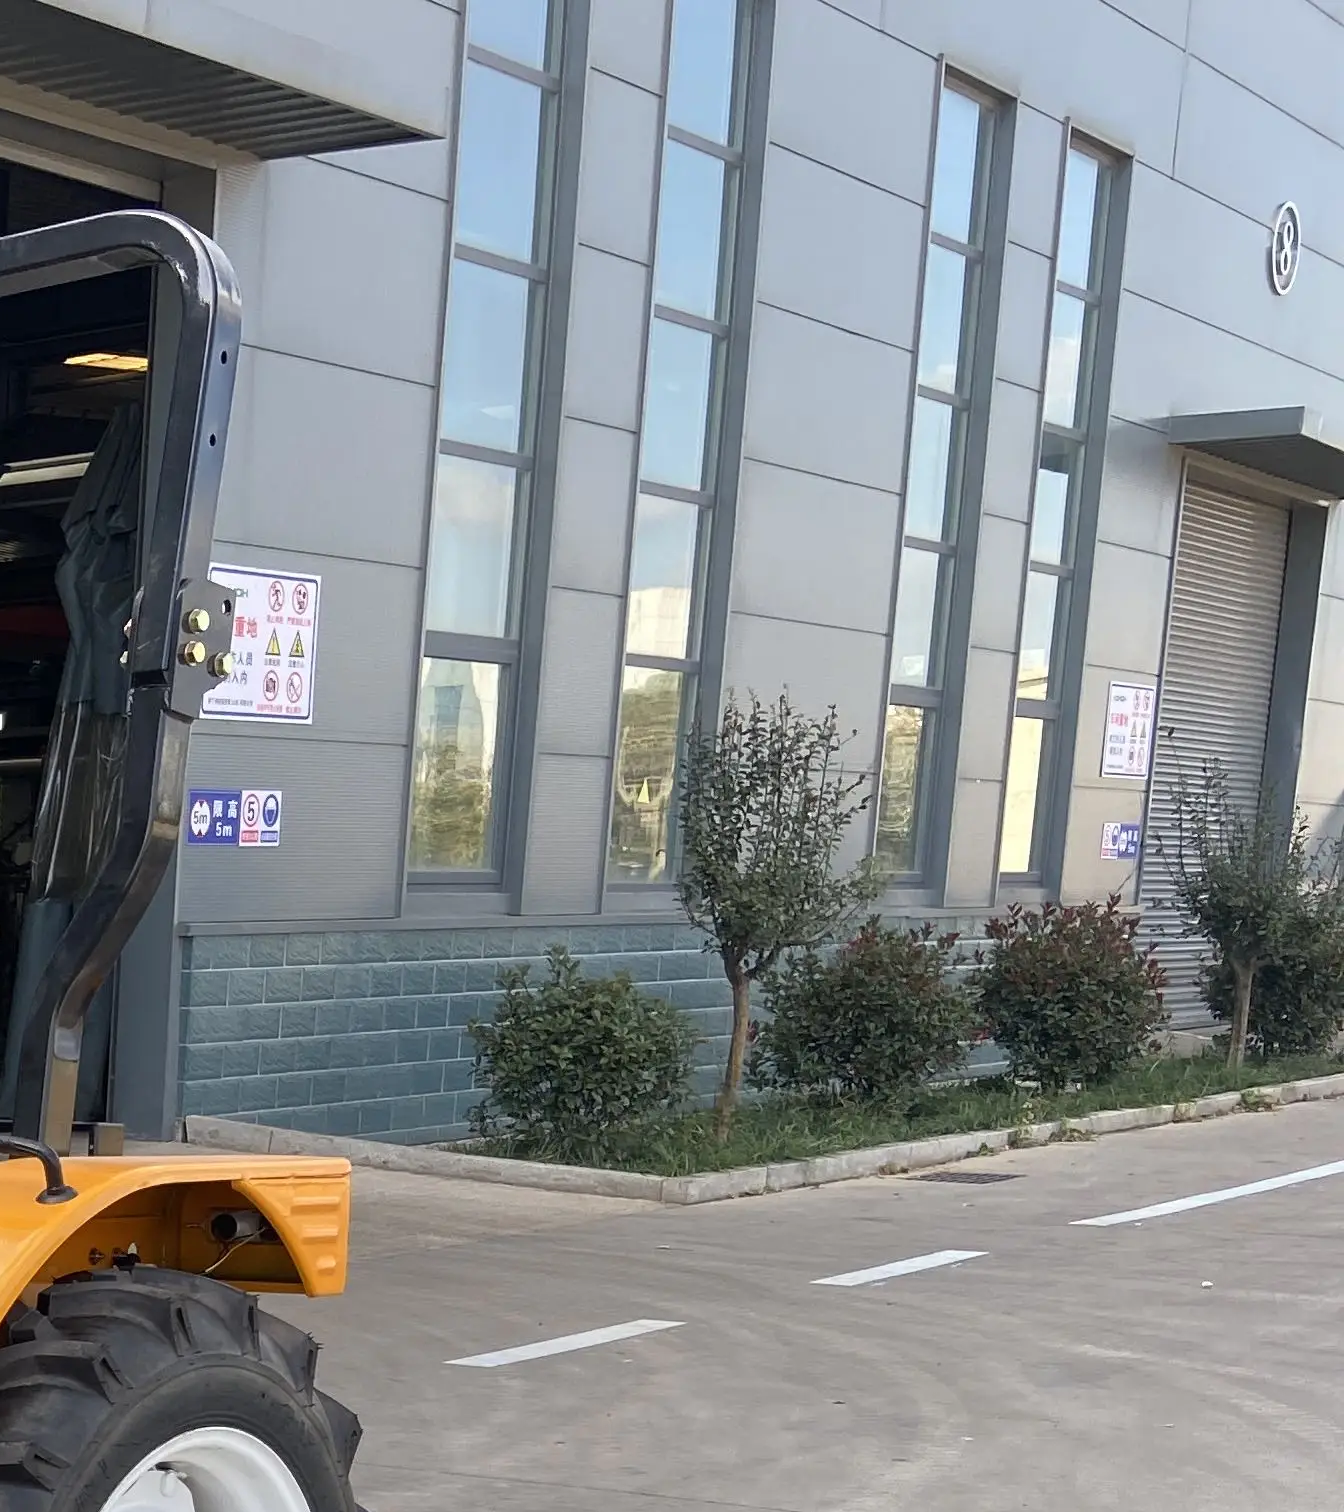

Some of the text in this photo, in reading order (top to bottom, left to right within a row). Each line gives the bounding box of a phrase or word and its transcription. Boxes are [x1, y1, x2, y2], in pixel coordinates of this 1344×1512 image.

[1280, 220, 1294, 276] 8
[234, 616, 258, 638] 重地
[193, 811, 208, 825] 5m
[247, 801, 255, 821] 5
[215, 822, 232, 837] 5m
